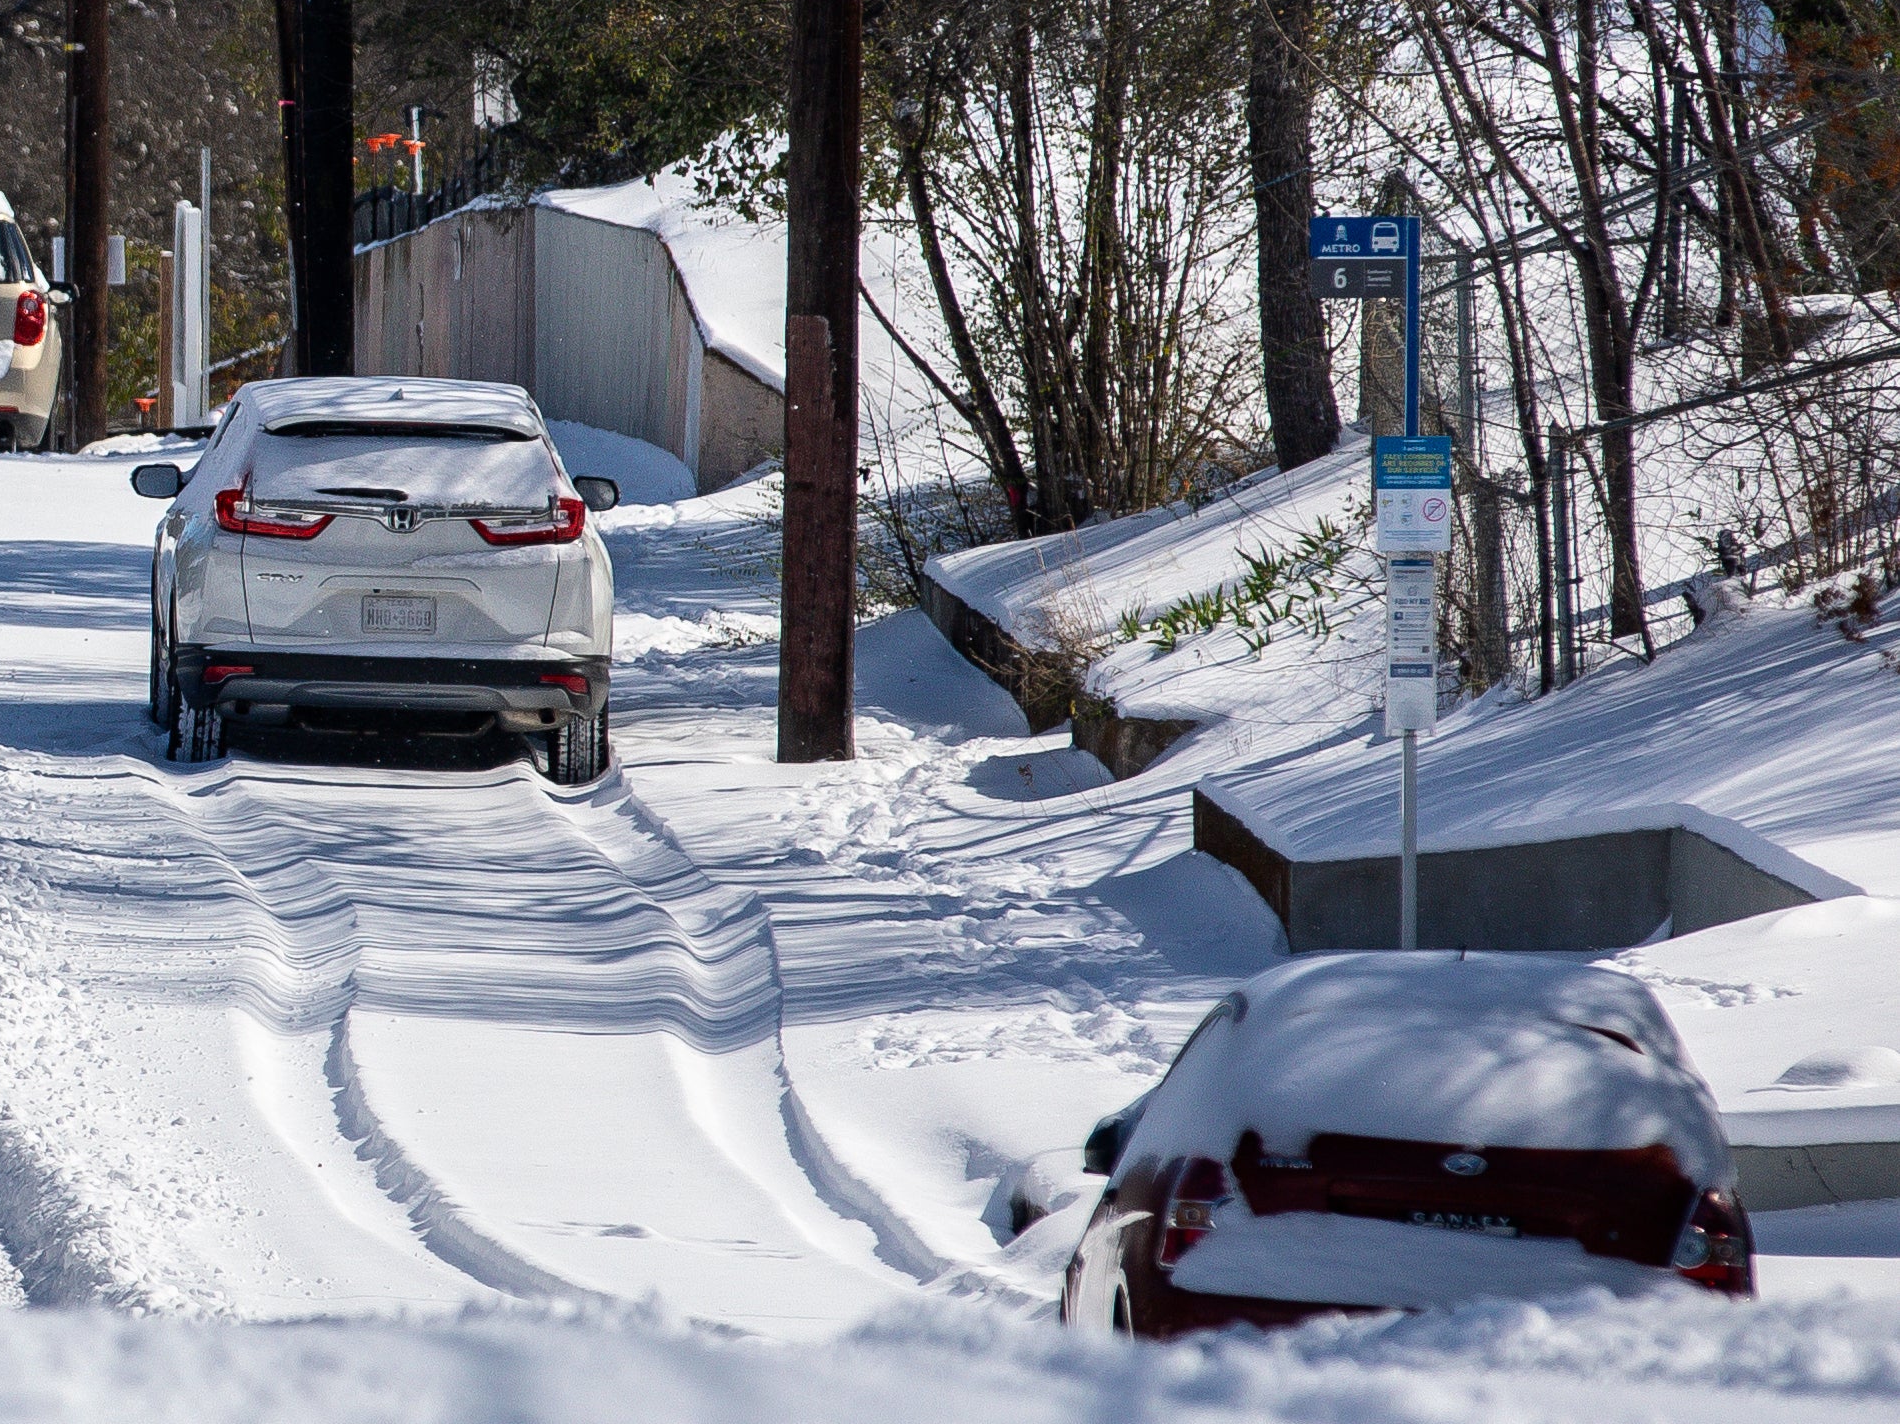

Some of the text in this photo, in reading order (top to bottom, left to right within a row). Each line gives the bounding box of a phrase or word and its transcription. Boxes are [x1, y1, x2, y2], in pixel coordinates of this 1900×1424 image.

[1321, 243, 1361, 253] METRO
[1334, 267, 1347, 289] 6
[256, 573, 304, 583] CR-V
[1413, 1211, 1511, 1226] GANLEY
